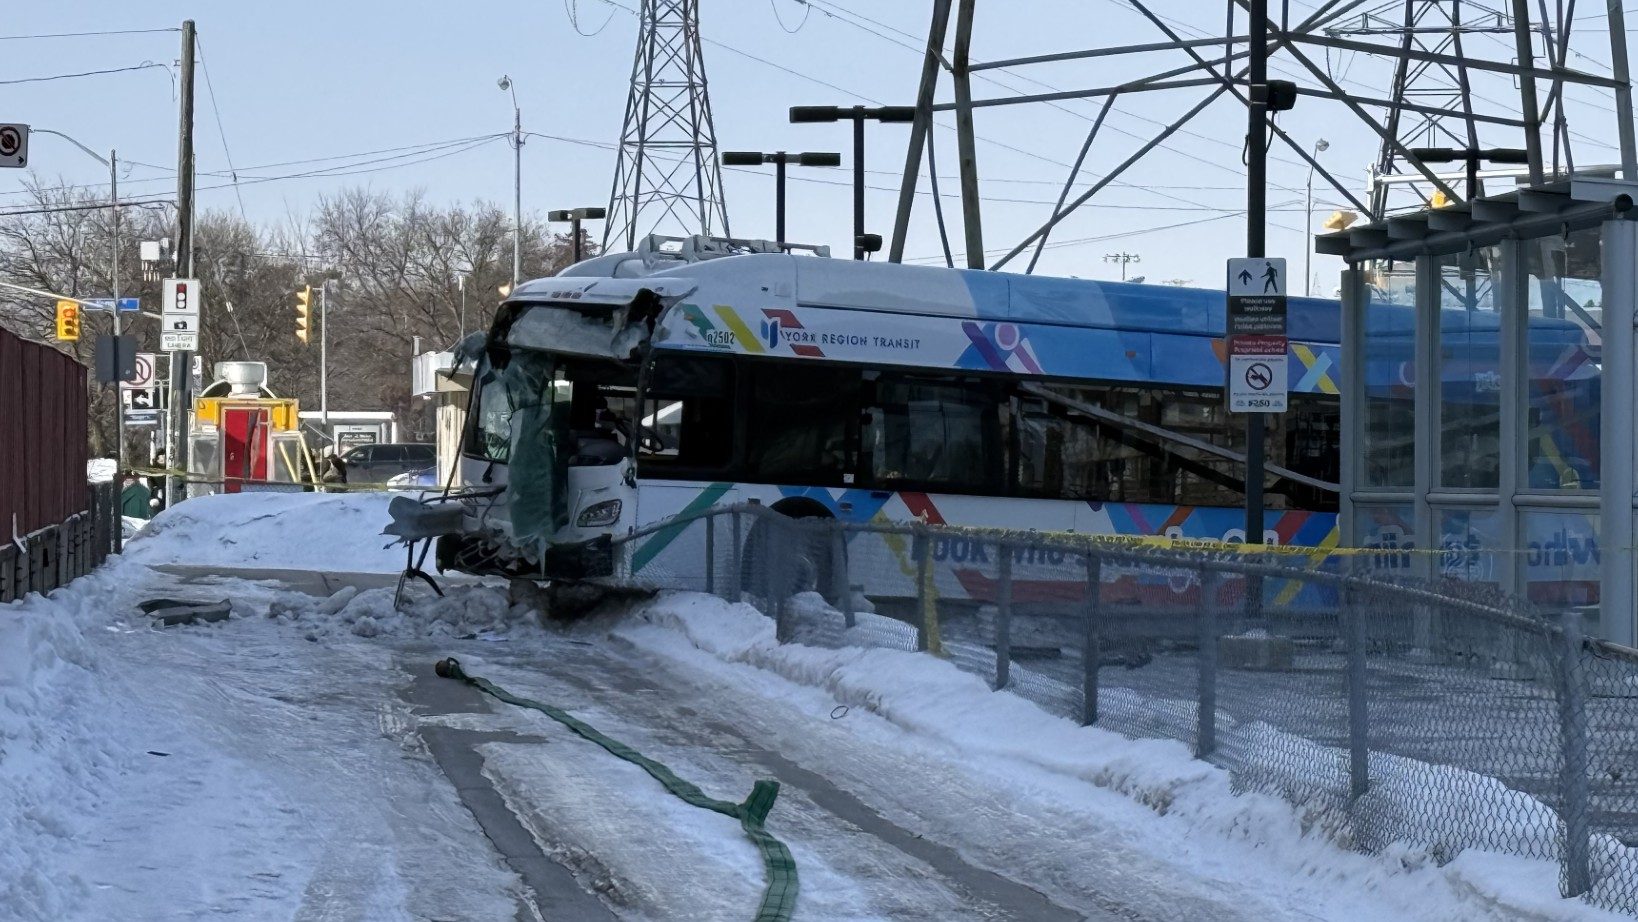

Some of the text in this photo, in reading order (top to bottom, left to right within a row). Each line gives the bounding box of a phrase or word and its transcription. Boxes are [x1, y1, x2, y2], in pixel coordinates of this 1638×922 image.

[785, 331, 920, 349] YORK REGION TRANSIT
